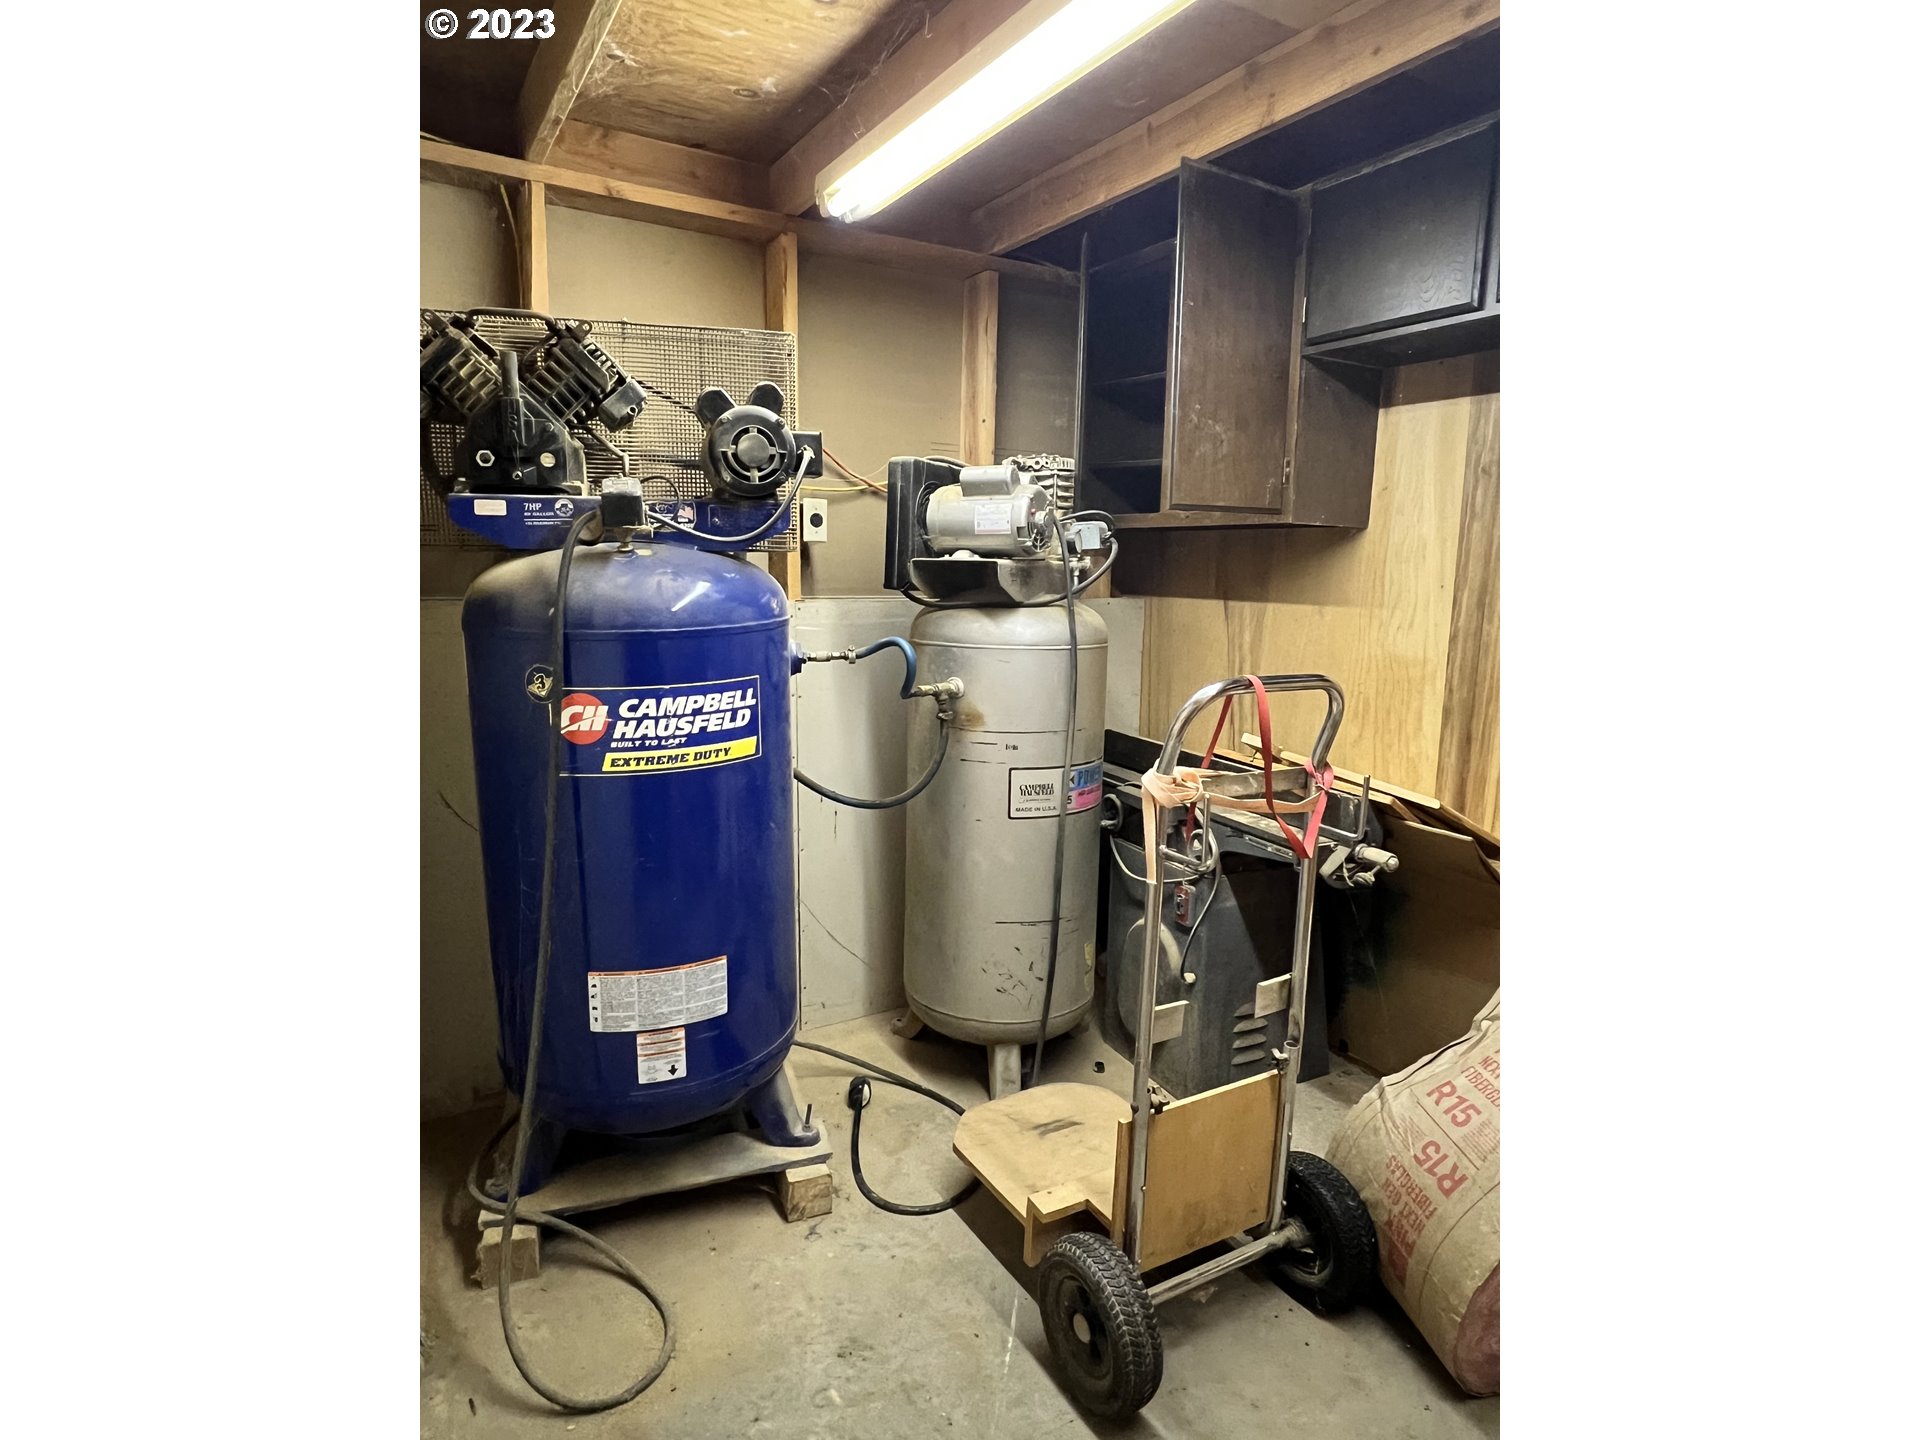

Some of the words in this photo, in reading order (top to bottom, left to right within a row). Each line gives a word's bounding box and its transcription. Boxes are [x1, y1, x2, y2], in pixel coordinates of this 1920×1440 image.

[523, 502, 542, 511] 7HP
[618, 687, 757, 719] CAMPBELL
[612, 708, 752, 740] HAUSFELD
[610, 740, 641, 749] BUILT
[645, 739, 659, 747] TO
[661, 737, 688, 747] LAST
[610, 752, 690, 768] EXTREME
[693, 746, 732, 762] DUTY
[1426, 1080, 1482, 1128] R15
[1460, 1065, 1500, 1111] FIBERGL
[1413, 1139, 1469, 1200] R15
